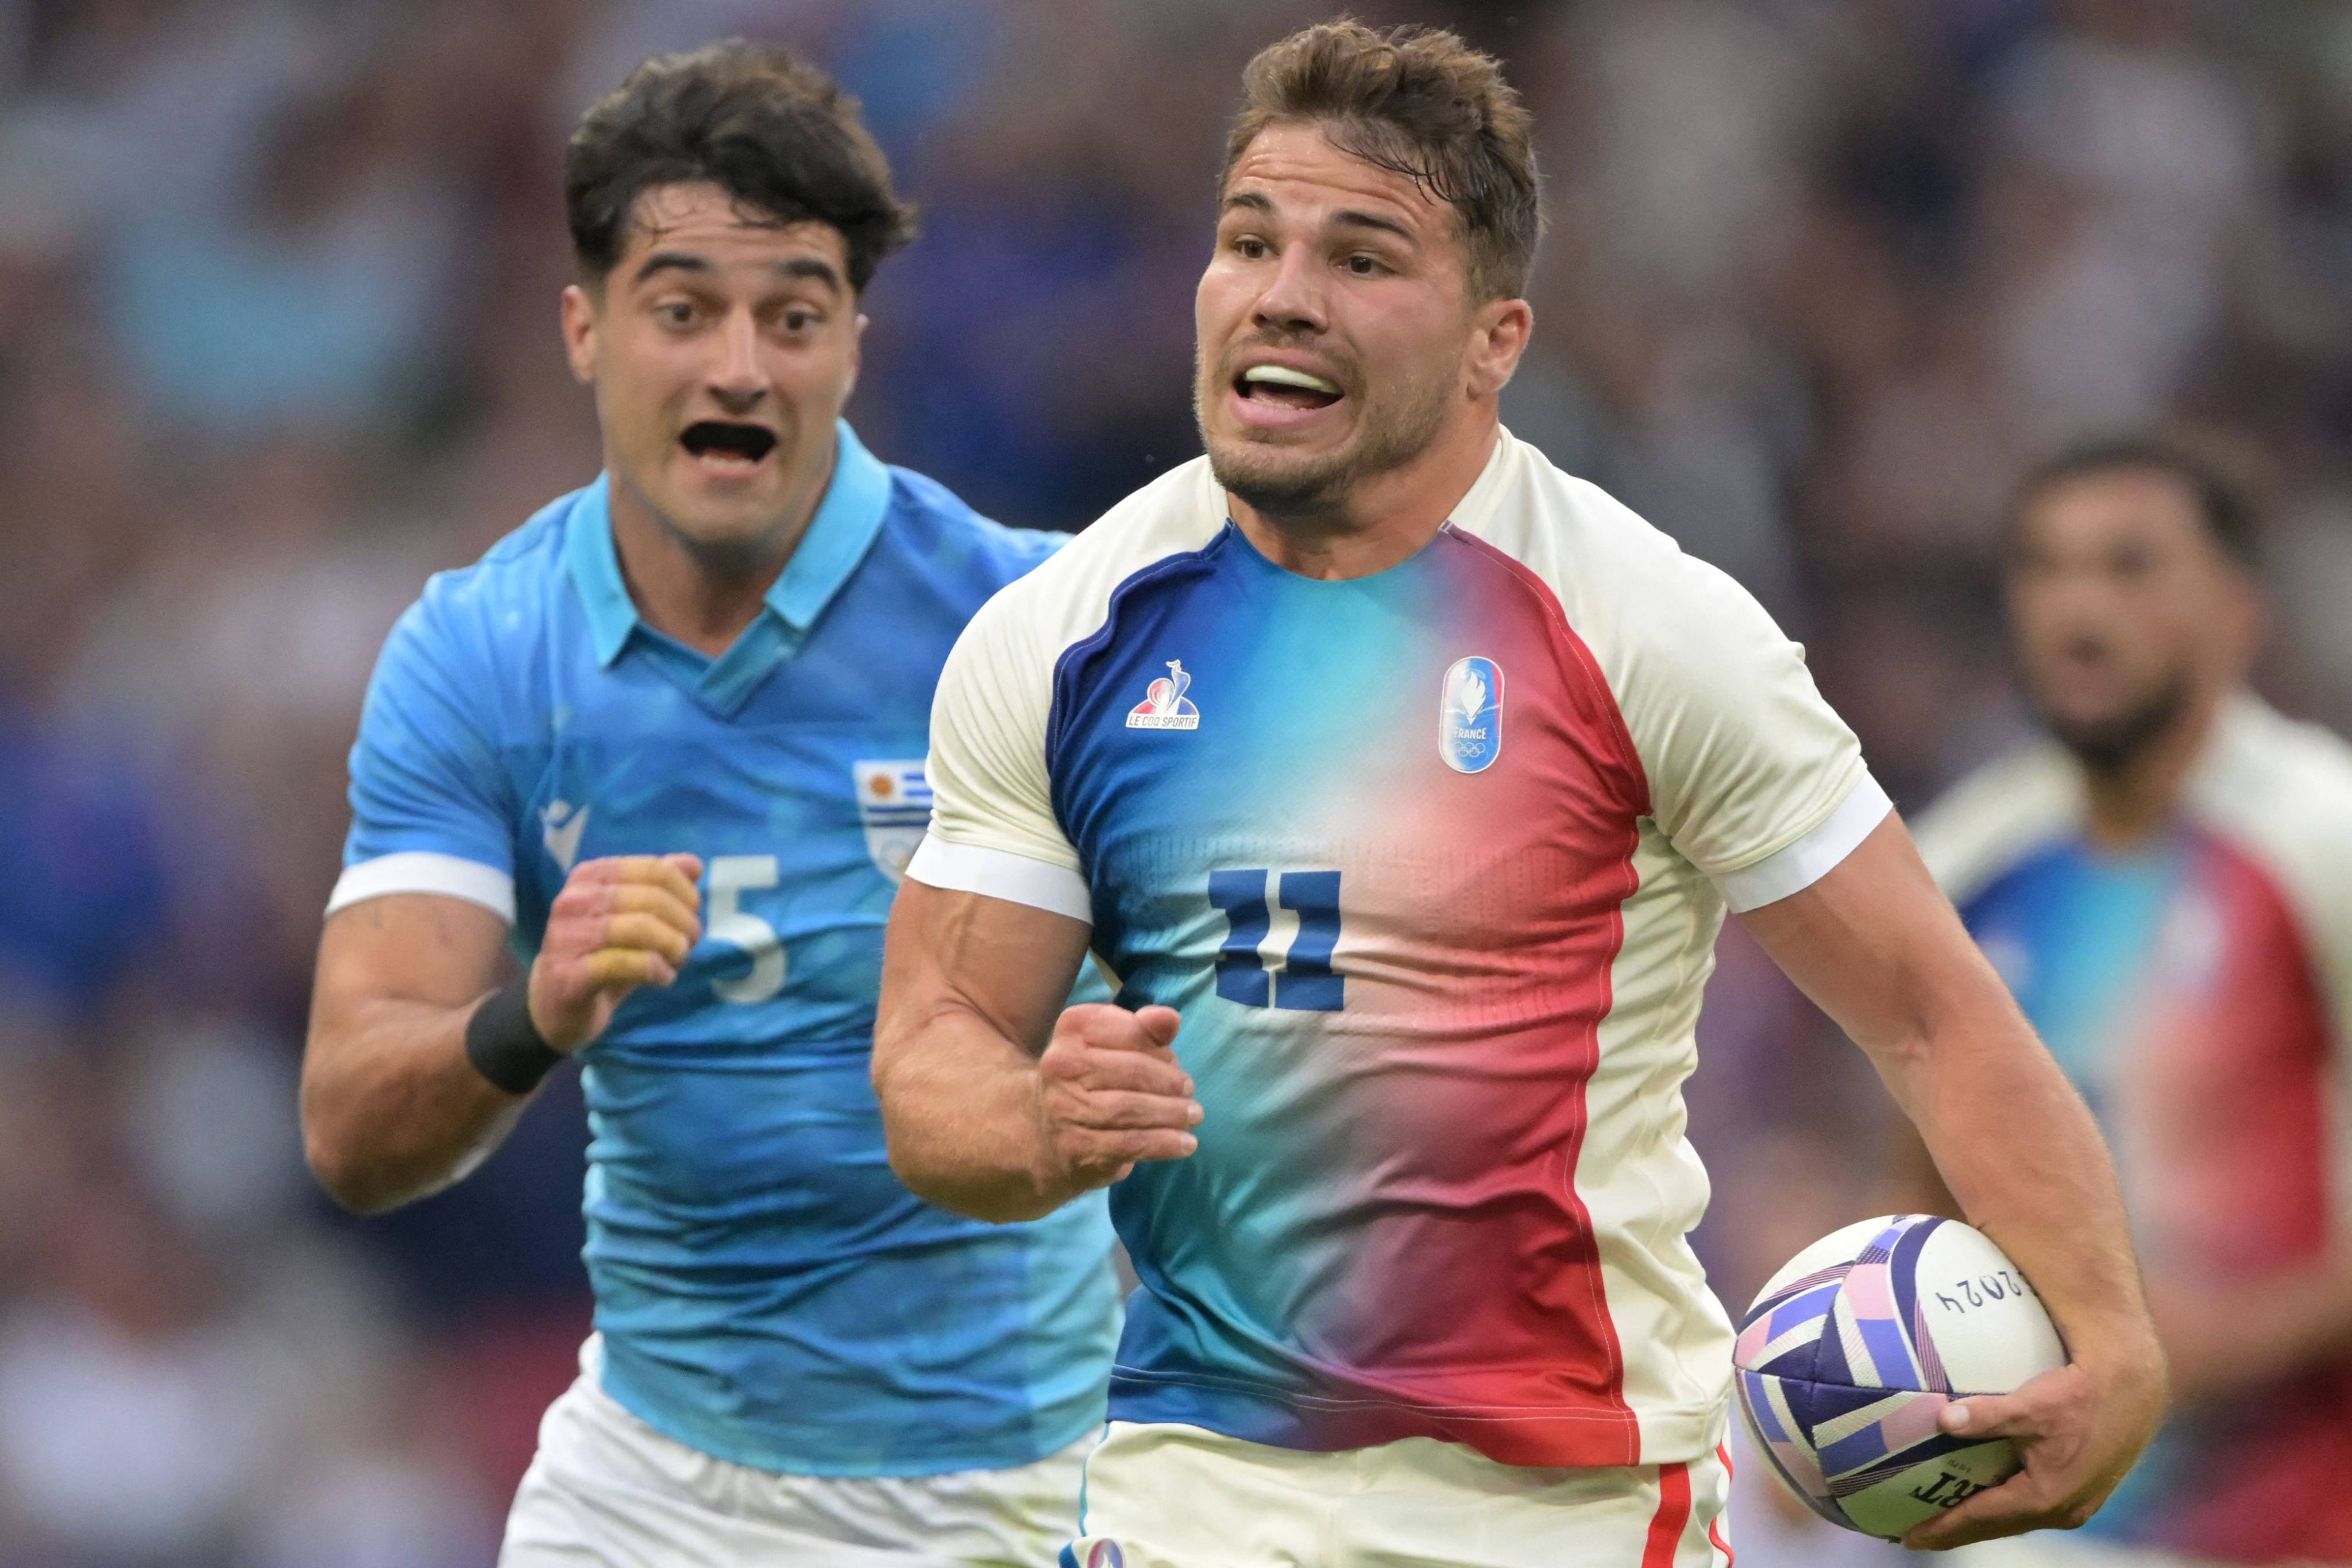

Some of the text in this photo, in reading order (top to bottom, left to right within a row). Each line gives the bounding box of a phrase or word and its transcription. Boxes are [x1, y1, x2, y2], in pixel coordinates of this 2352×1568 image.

[1129, 716, 1198, 728] LE COQ SPORTIF
[1454, 727, 1486, 739] FRANCE
[708, 856, 785, 1003] 5
[1208, 869, 1345, 1011] 11
[1936, 1271, 2022, 1314] 2024
